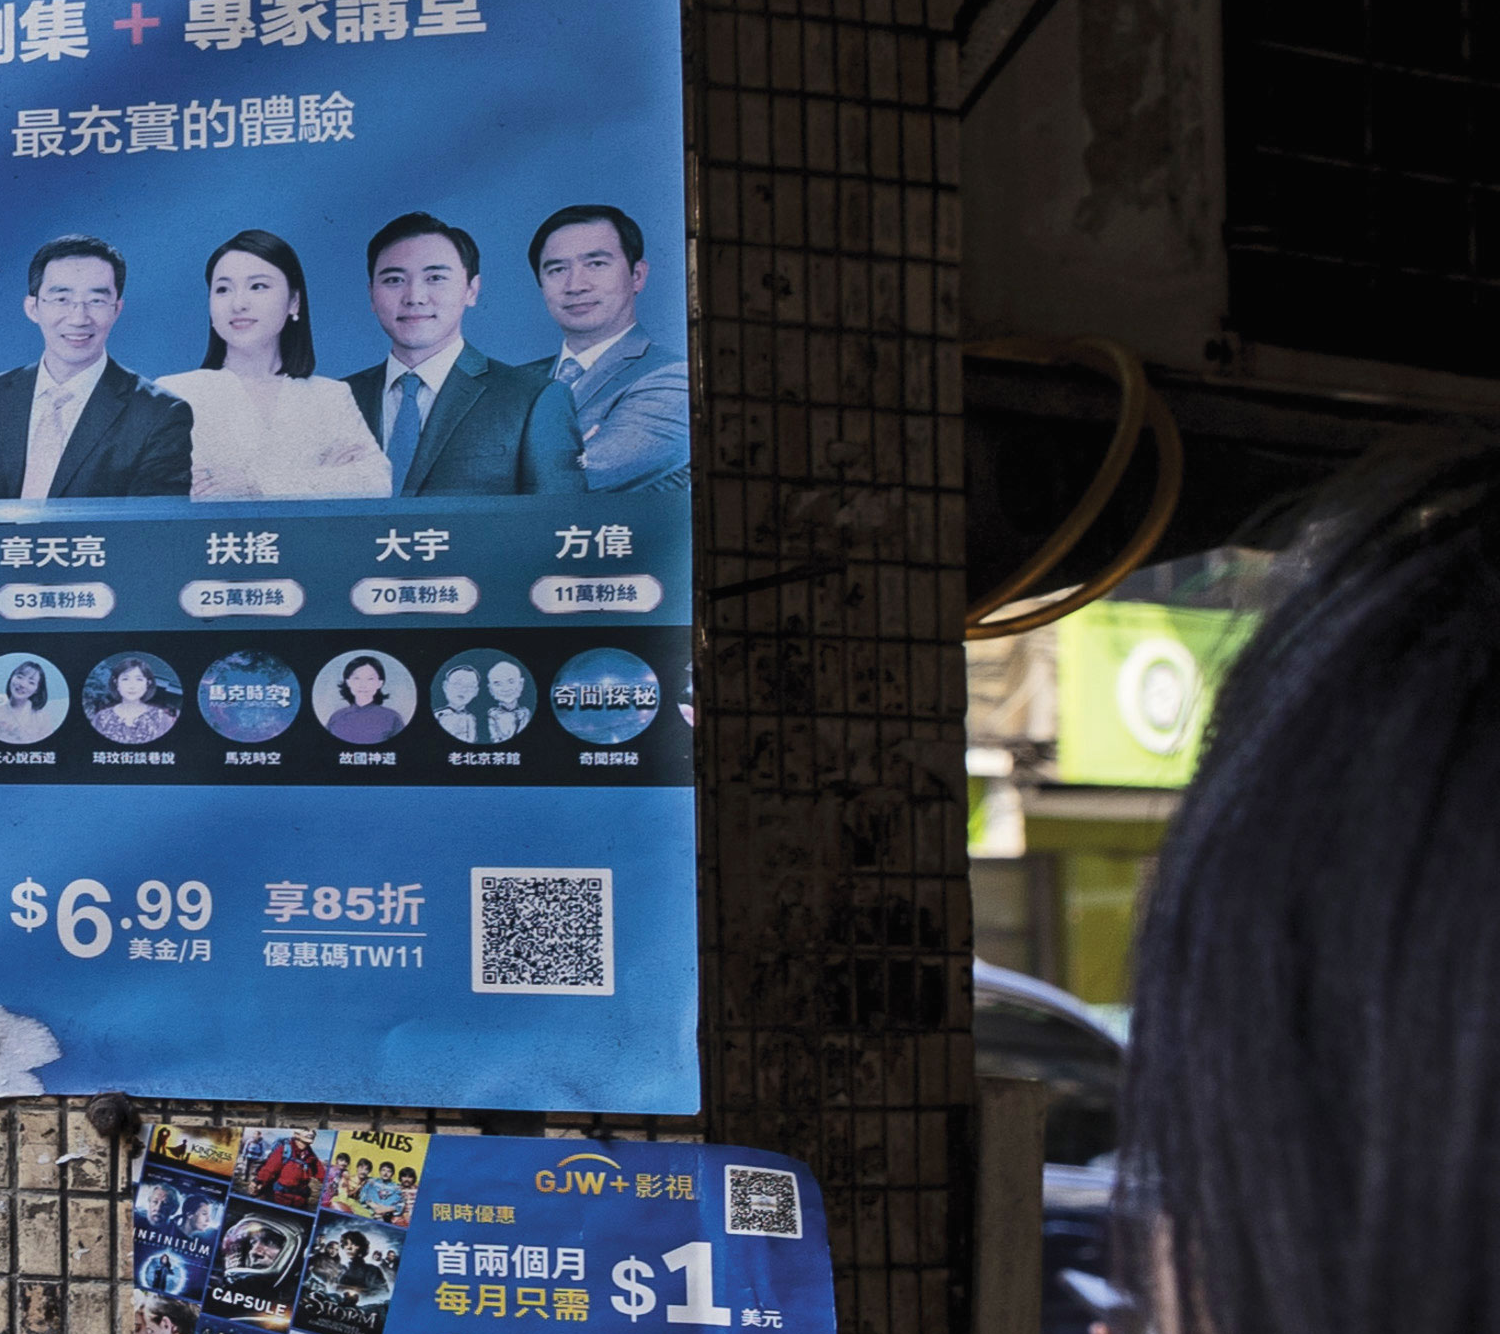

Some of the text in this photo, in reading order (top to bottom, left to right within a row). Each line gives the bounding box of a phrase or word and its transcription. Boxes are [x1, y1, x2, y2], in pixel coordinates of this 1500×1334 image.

[11, 90, 356, 159] 最充實的體驗
[0, 535, 106, 568] 章天亮
[205, 531, 281, 567] 扶搖
[375, 529, 451, 562] 大宇
[554, 524, 634, 561] 方偉
[14, 591, 96, 608] 53萬粉絲
[200, 586, 286, 609] 25萬粉絲
[371, 584, 460, 608] 70萬粉絲
[554, 582, 639, 605] 11萬粉絲
[553, 684, 657, 710] 奇聞探秘
[224, 751, 282, 766] 馬克時空
[448, 752, 521, 766] 老北京茶館
[579, 752, 639, 766] 奇聞探秘
[9, 877, 214, 958] $6.99
[263, 880, 427, 926] 享85折
[127, 938, 212, 963] 美金/月
[263, 941, 425, 970] 優惠碼TW11
[190, 1144, 232, 1161] KINDNESS
[432, 1203, 516, 1224] 限時優惠
[433, 1242, 585, 1281] 首兩個月
[610, 1241, 783, 1329] $1 美元
[212, 1287, 287, 1317] CAPSULE
[305, 1291, 378, 1329] STORM
[435, 1281, 590, 1322] 每月只需
